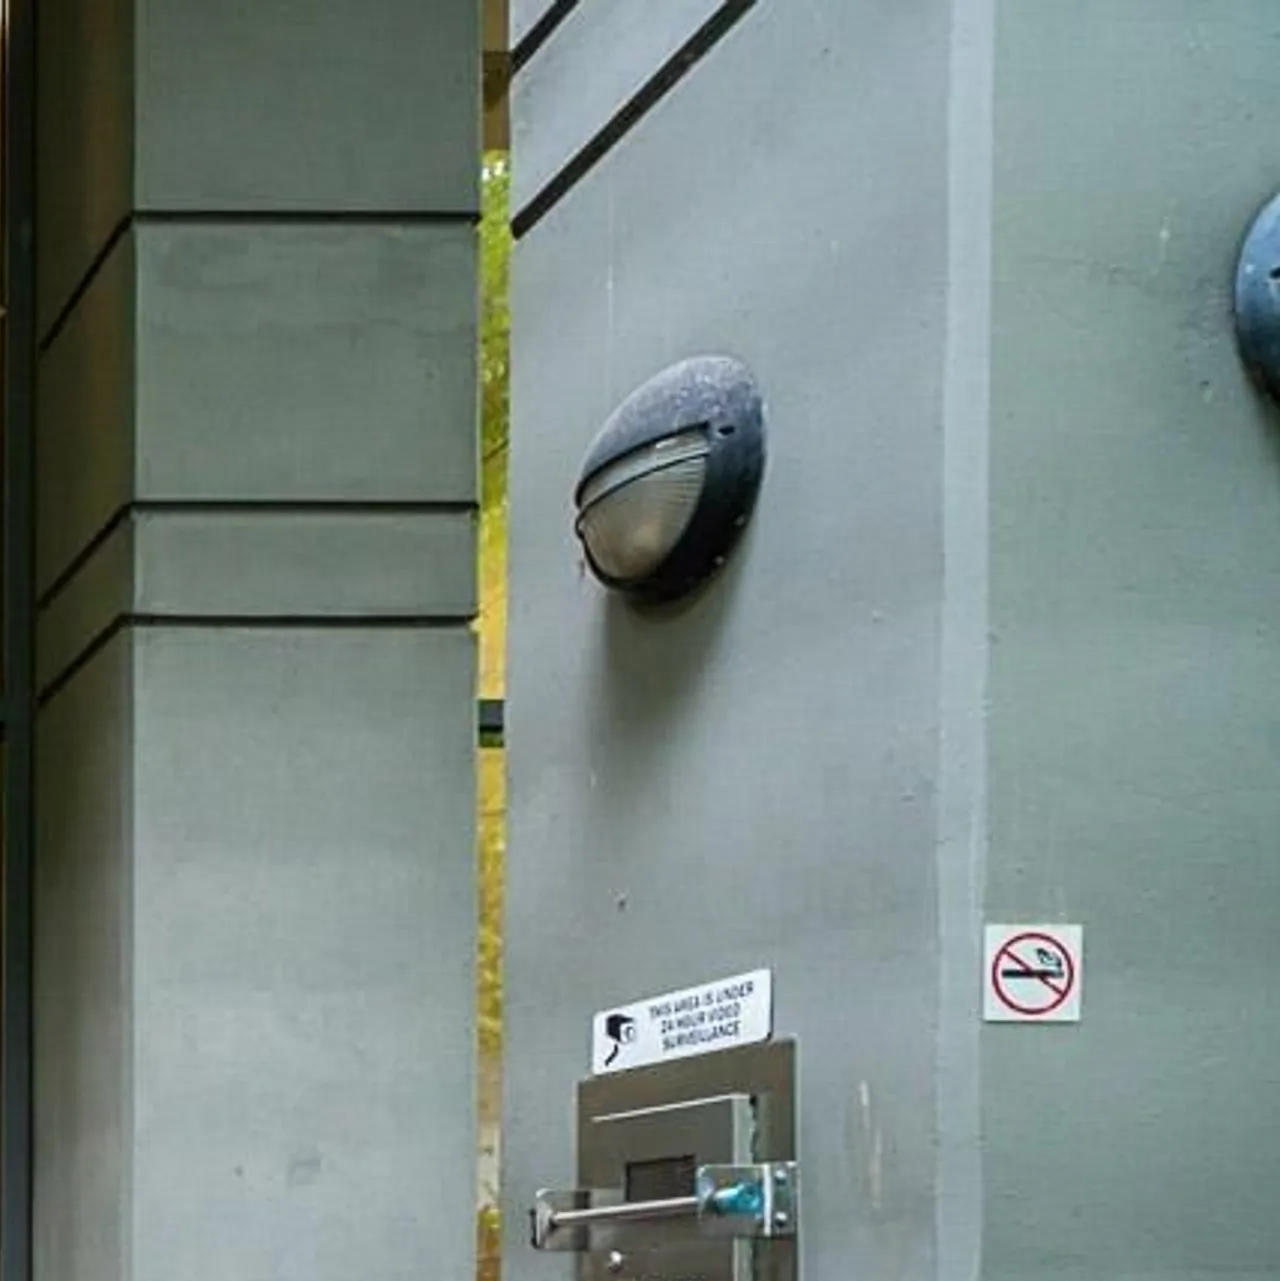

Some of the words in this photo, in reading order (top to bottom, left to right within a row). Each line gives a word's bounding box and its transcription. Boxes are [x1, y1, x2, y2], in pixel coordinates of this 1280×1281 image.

[649, 1002, 672, 1019] THIS
[674, 995, 700, 1013] AREA
[703, 991, 714, 1006] IS
[716, 980, 754, 1002] UNDER
[660, 1019, 674, 1034] 24
[676, 1010, 705, 1029] HOUR
[708, 1001, 742, 1023] VIDEO
[661, 1020, 742, 1052] SURVEILLANCE
